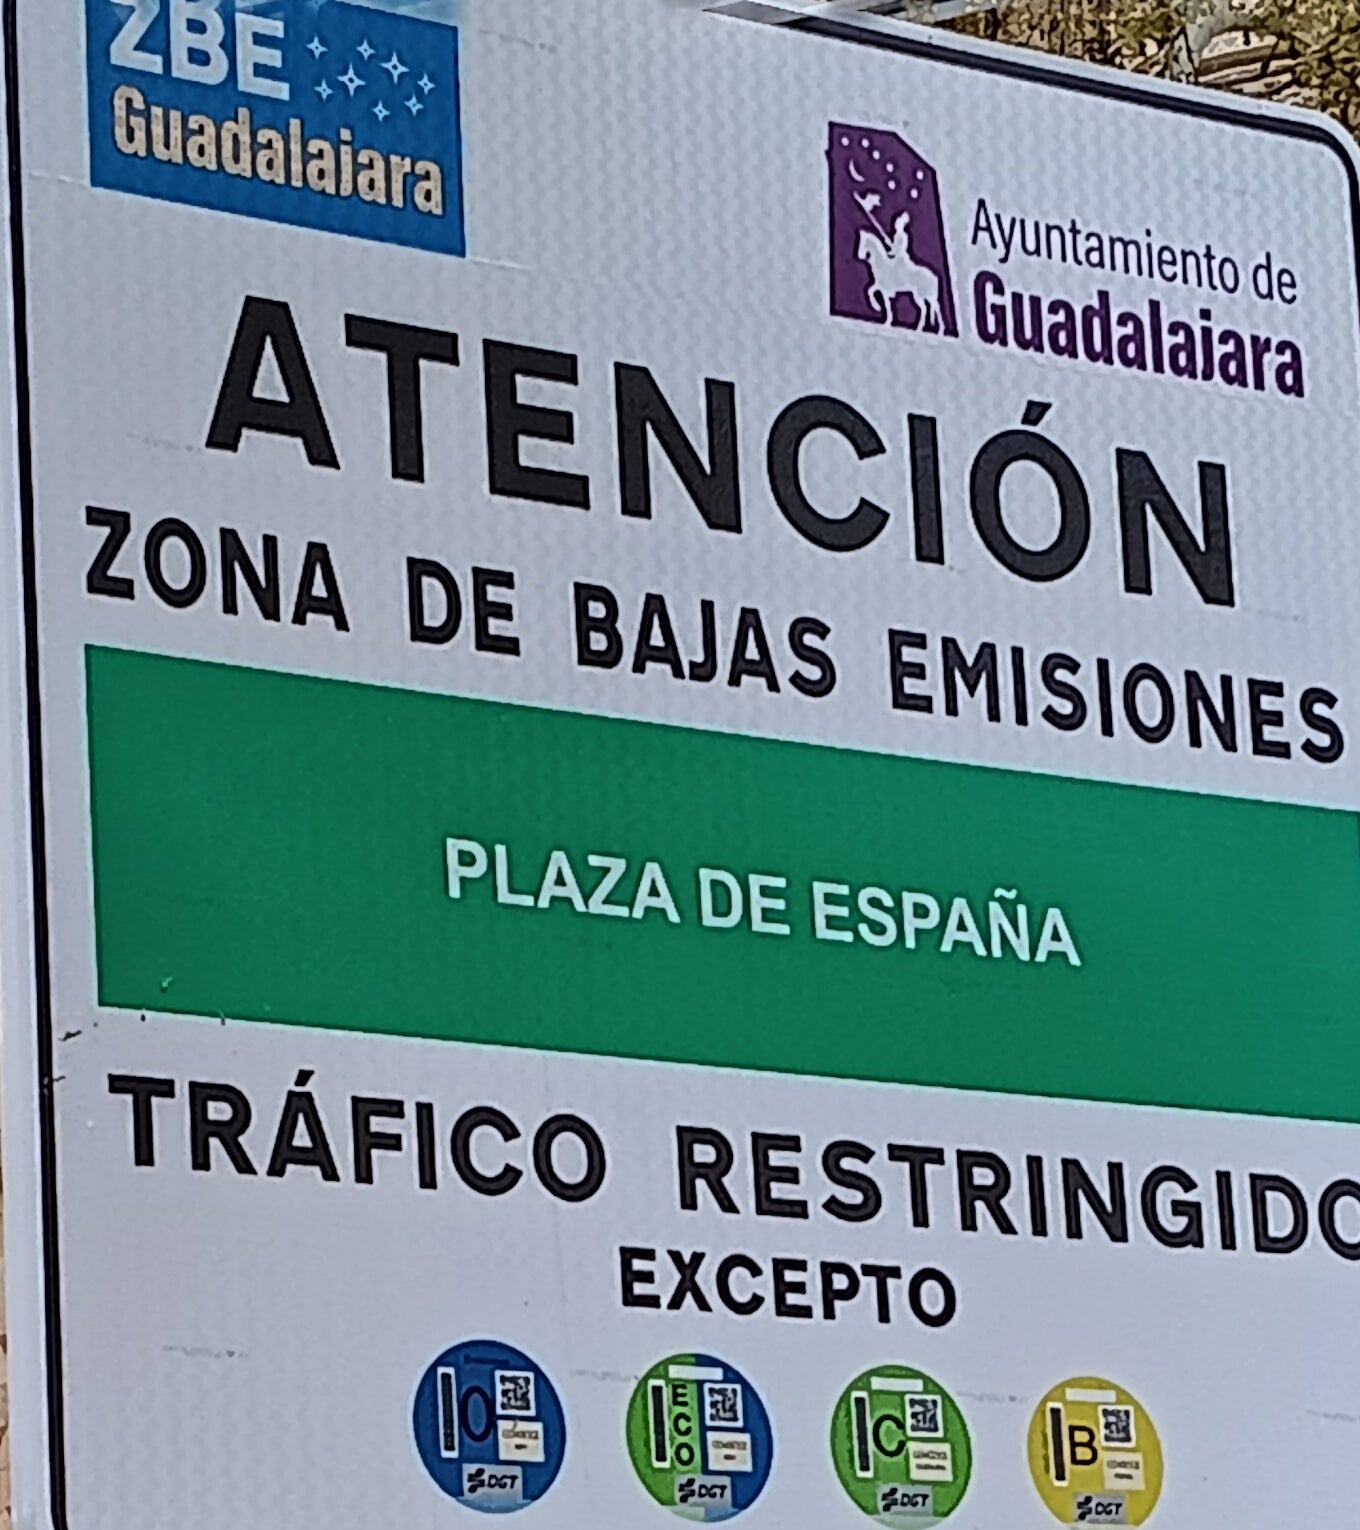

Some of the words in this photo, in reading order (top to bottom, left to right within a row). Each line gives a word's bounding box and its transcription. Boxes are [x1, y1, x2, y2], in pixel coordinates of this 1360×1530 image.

[109, 0, 291, 101] ZBE
[113, 84, 444, 216] Guadalajara
[971, 198, 1240, 294] Ayuntamiento
[1252, 251, 1298, 305] de
[972, 269, 1305, 398] Guadalajara
[205, 295, 1236, 608] ATENCIÓN
[85, 505, 350, 633] ZONA
[406, 556, 521, 657] DE
[573, 581, 837, 698] BAJAS
[888, 628, 1346, 764] EMISIONES
[445, 837, 681, 923] PLAZA
[698, 867, 791, 935] DE
[811, 879, 1082, 967] ESPAÑA
[107, 1069, 607, 1203] TRÁFICO
[618, 1246, 958, 1329] EXCEPTO
[487, 1474, 519, 1491] DGT
[872, 1413, 908, 1458] C
[1067, 1425, 1099, 1467] B
[697, 1484, 728, 1500] DGT
